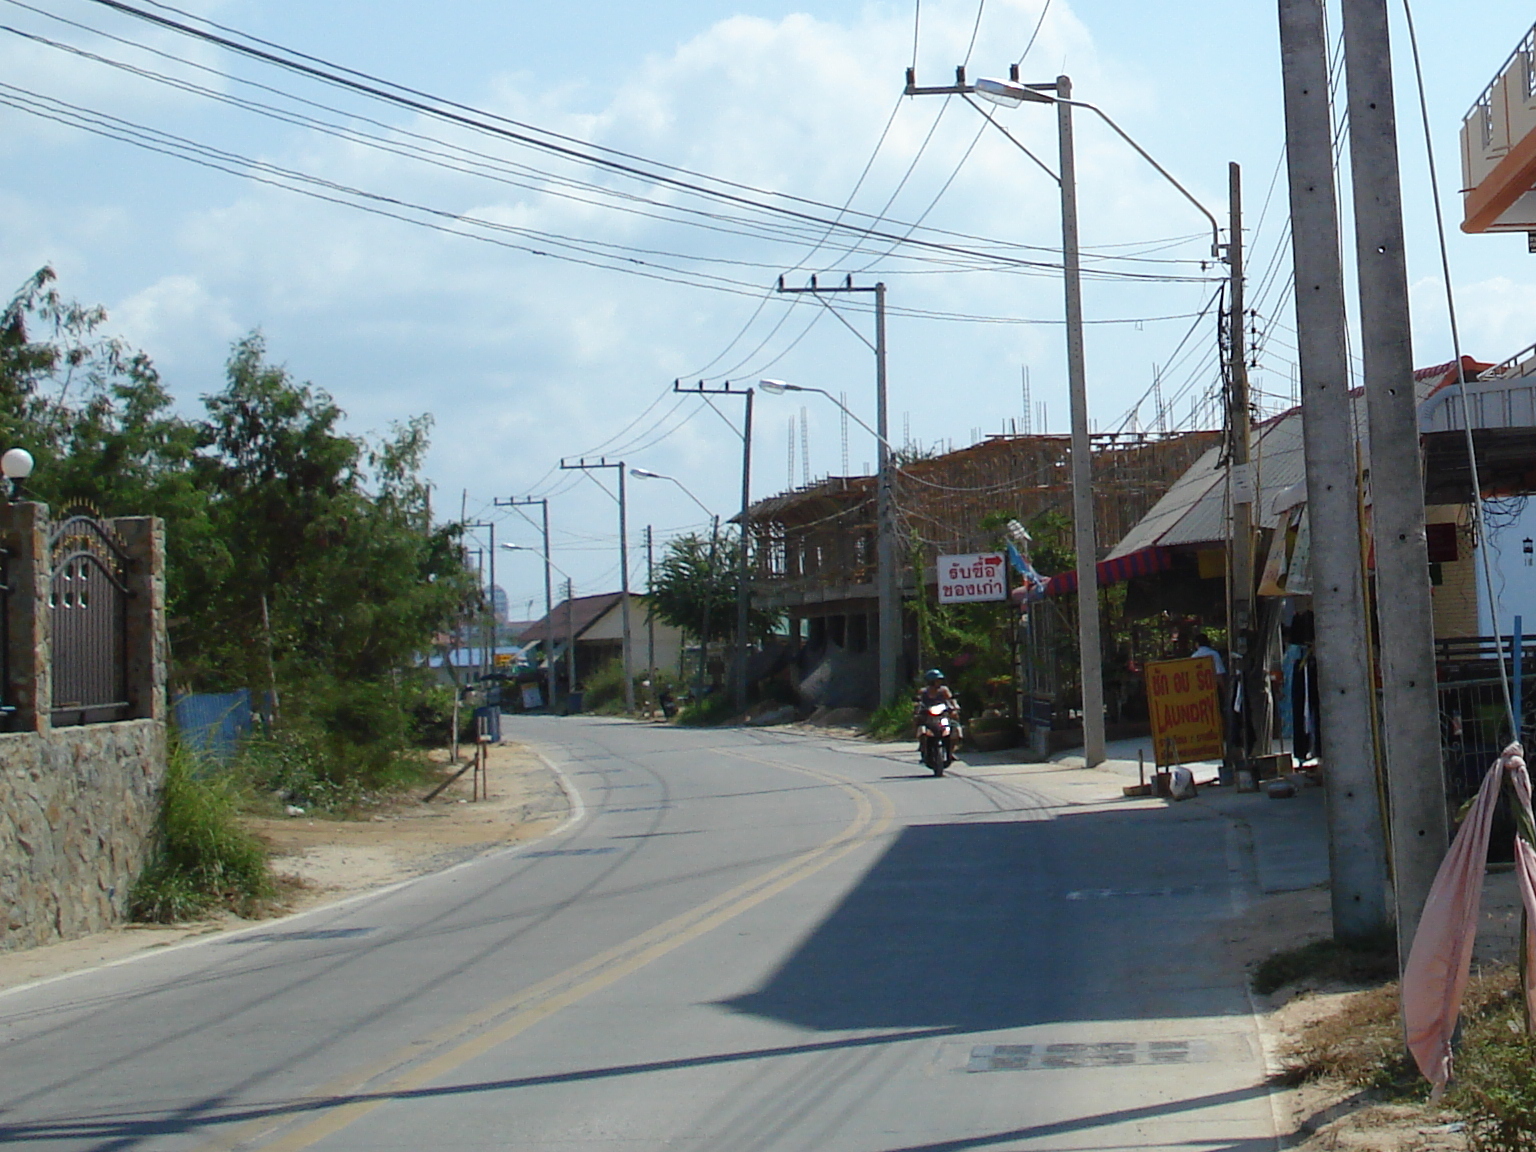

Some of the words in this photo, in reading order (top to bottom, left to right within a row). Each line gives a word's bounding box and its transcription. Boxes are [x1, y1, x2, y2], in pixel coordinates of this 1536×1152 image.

[949, 556, 995, 578] รับซื้อ
[943, 580, 1002, 597] ของเก่า
[1155, 693, 1215, 733] LAUNDRY
